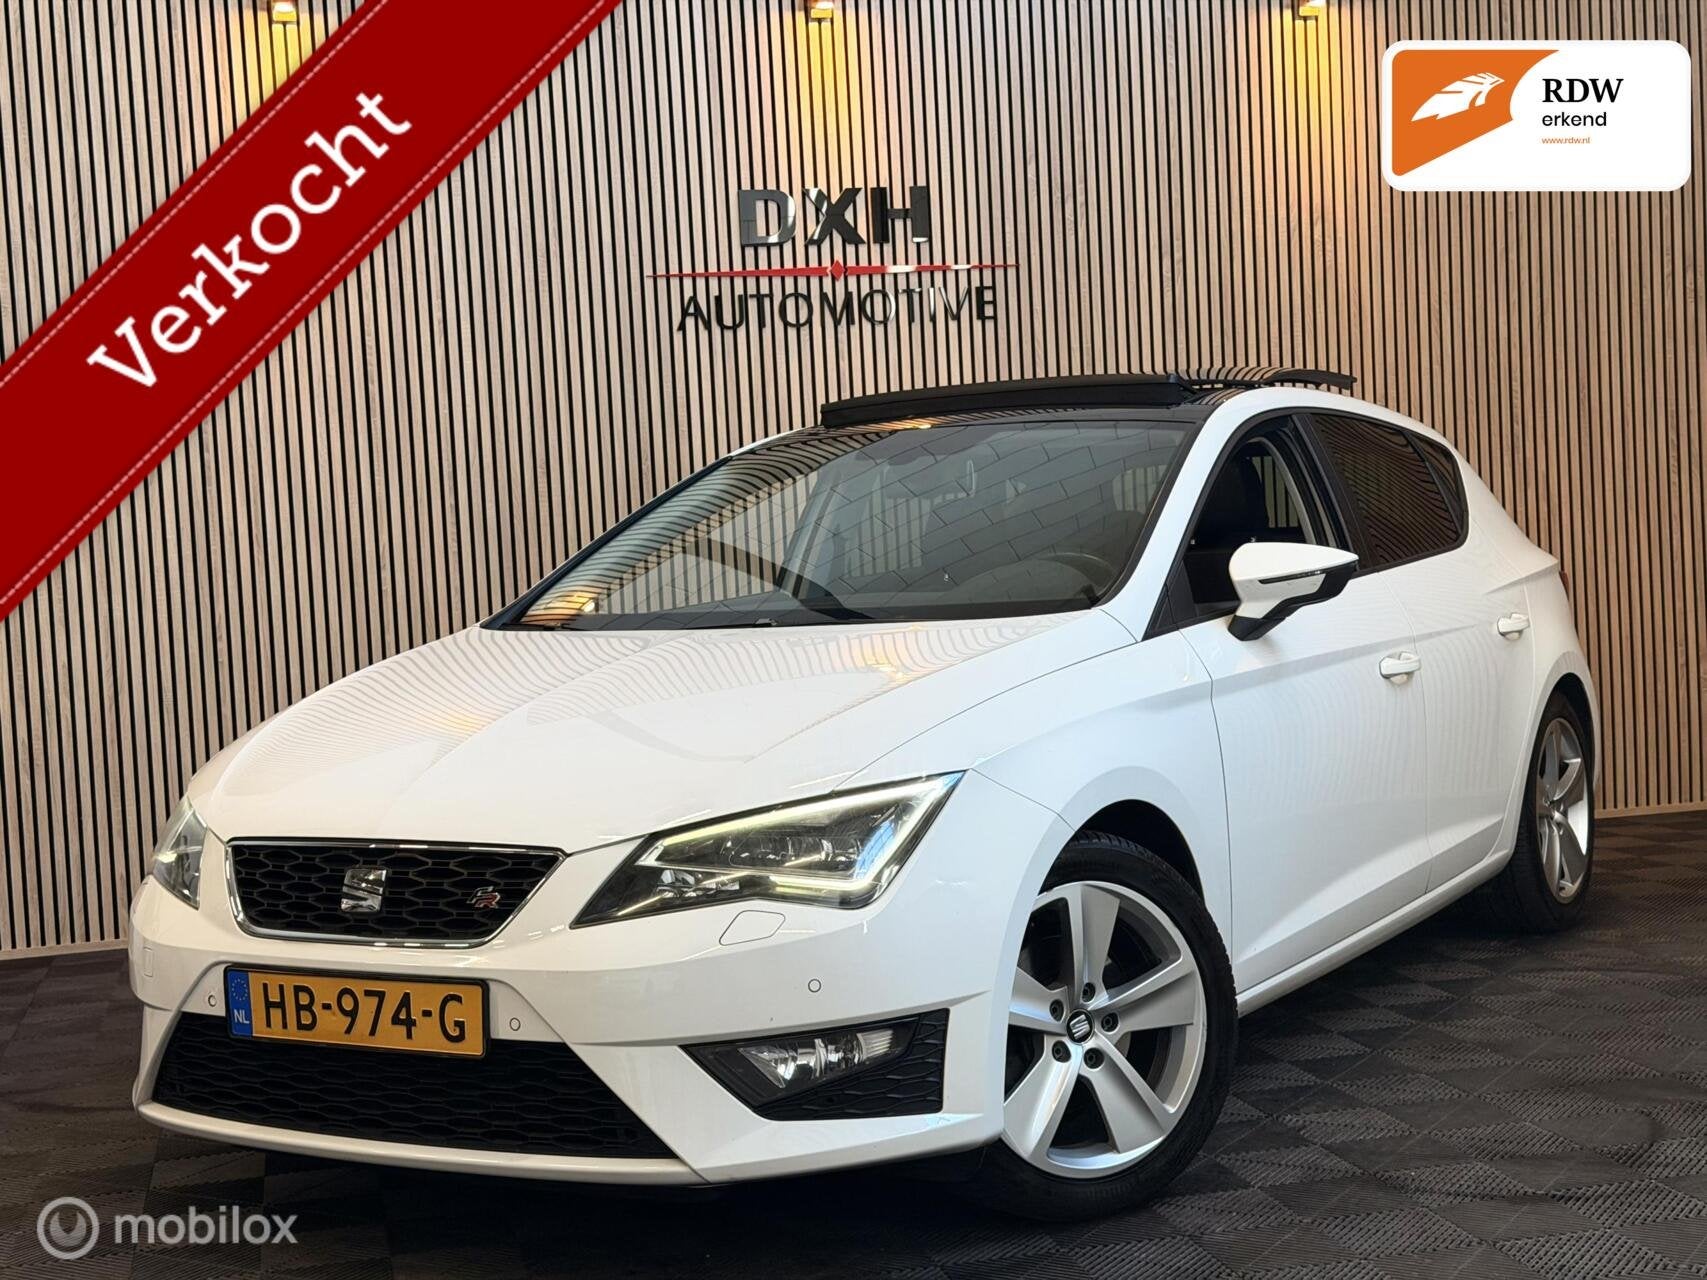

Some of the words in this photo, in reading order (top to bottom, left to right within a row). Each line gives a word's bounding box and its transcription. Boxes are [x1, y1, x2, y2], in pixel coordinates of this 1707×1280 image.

[737, 185, 930, 248] DXH
[677, 285, 996, 332] AUTOMOTIVE
[233, 1009, 250, 1025] NL
[262, 981, 466, 1044] HB-974-G
